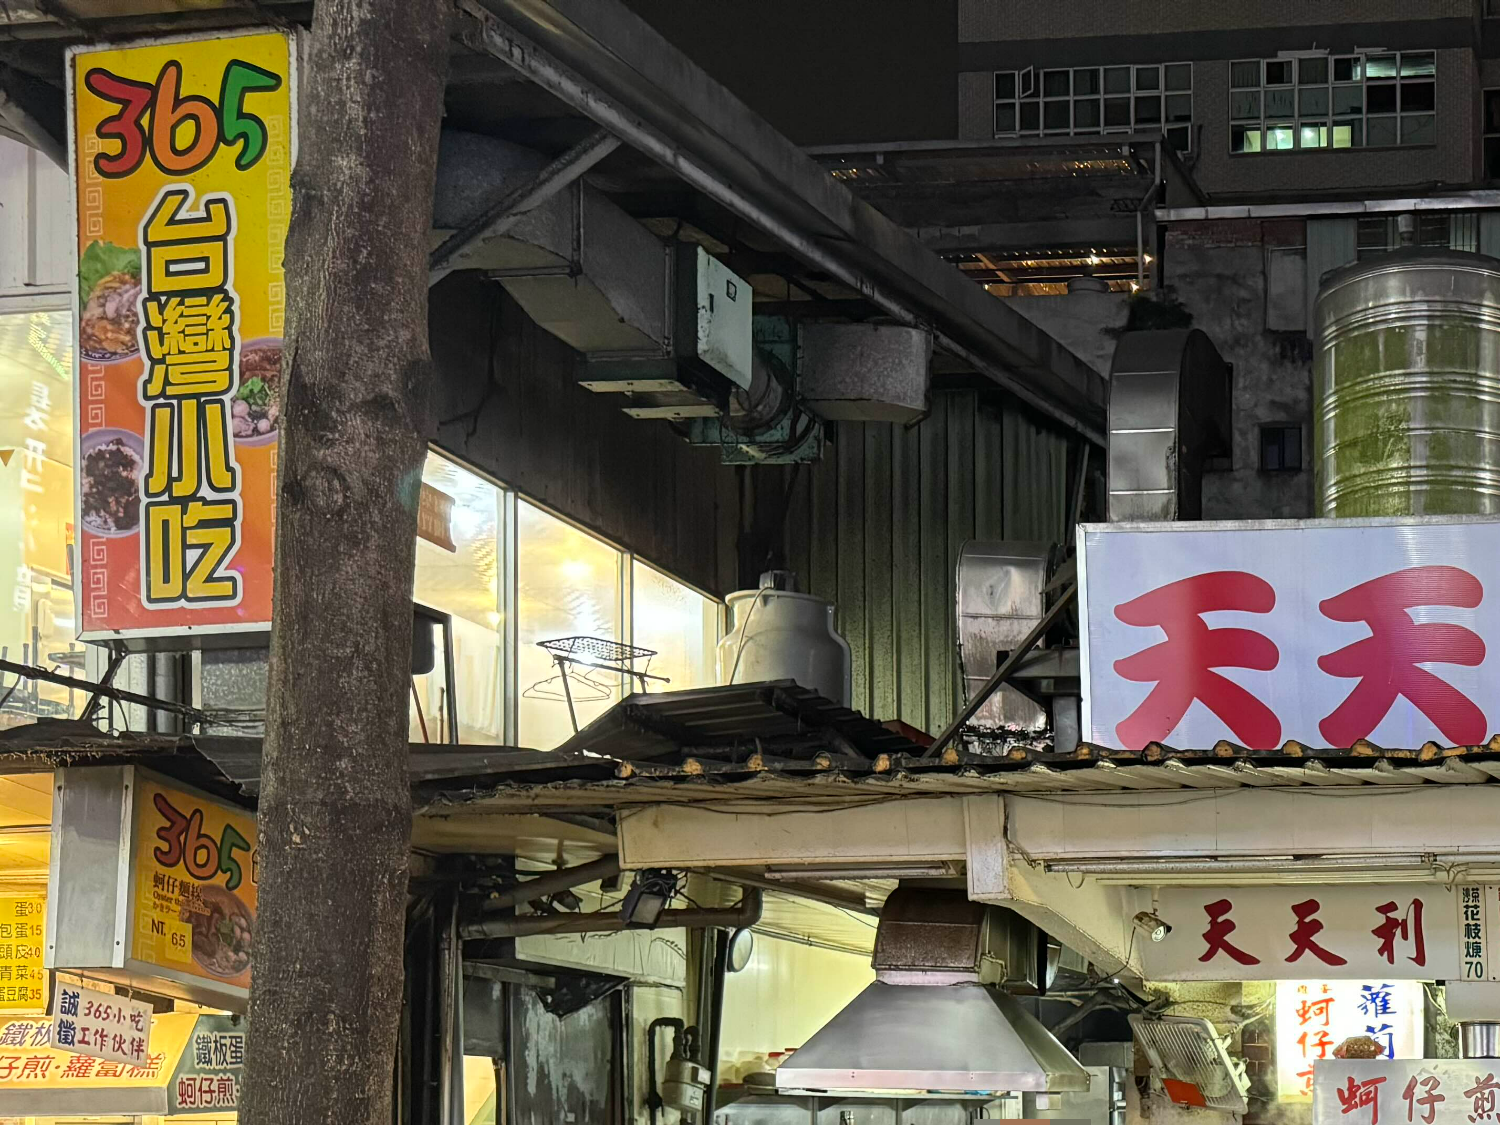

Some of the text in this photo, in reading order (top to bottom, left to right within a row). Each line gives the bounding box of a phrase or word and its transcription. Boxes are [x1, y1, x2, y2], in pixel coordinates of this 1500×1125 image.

[85, 59, 282, 179] 365
[143, 188, 237, 604] 台灣小吃
[153, 793, 251, 891] 365
[29, 924, 42, 936] 15
[171, 933, 186, 948] 65
[1198, 898, 1426, 967] 天天利
[29, 969, 44, 981] 45
[1465, 961, 1483, 979] 70
[29, 989, 42, 1000] 35
[57, 988, 80, 1048] 誠徵
[84, 1000, 144, 1033] 365小吃
[77, 1026, 145, 1061] 工作伙伴
